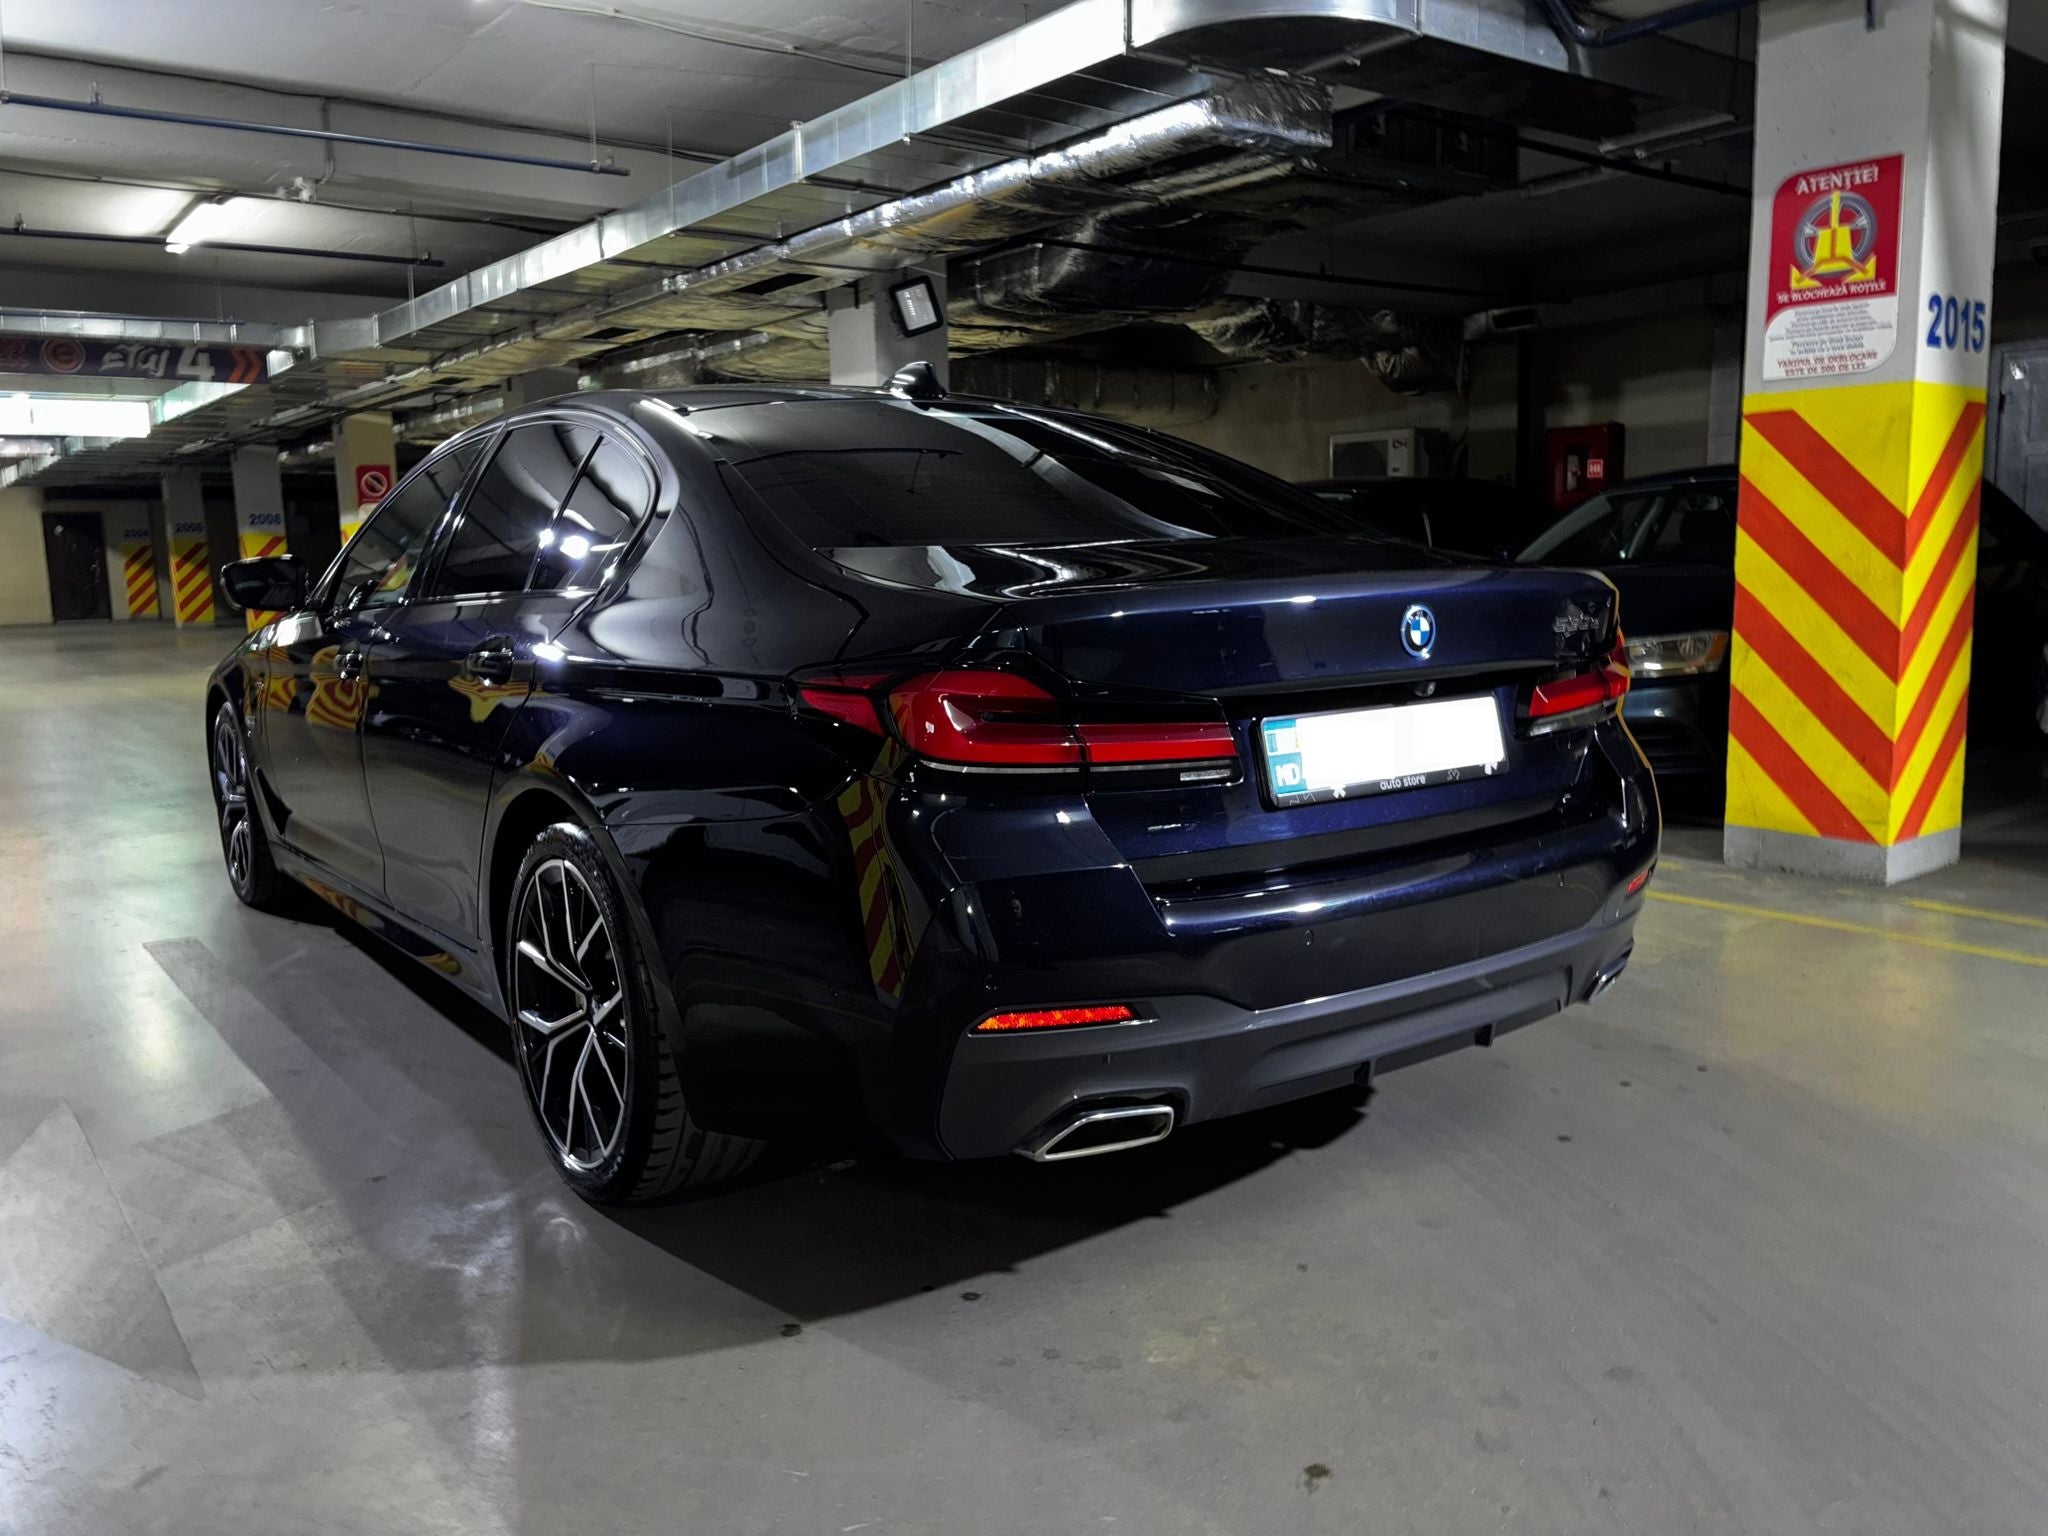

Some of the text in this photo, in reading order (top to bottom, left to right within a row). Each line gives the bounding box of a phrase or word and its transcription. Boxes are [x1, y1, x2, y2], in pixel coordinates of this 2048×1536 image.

[1926, 294, 1986, 354] 2015
[175, 345, 216, 381] 4
[1814, 356, 1826, 365] DE
[1785, 366, 1805, 377] ESTE
[1807, 365, 1819, 375] DE
[1821, 364, 1837, 374] 500
[1838, 363, 1850, 372] DE
[249, 513, 282, 525] 2008
[1275, 763, 1300, 787] MD
[1380, 774, 1427, 791] auto store
